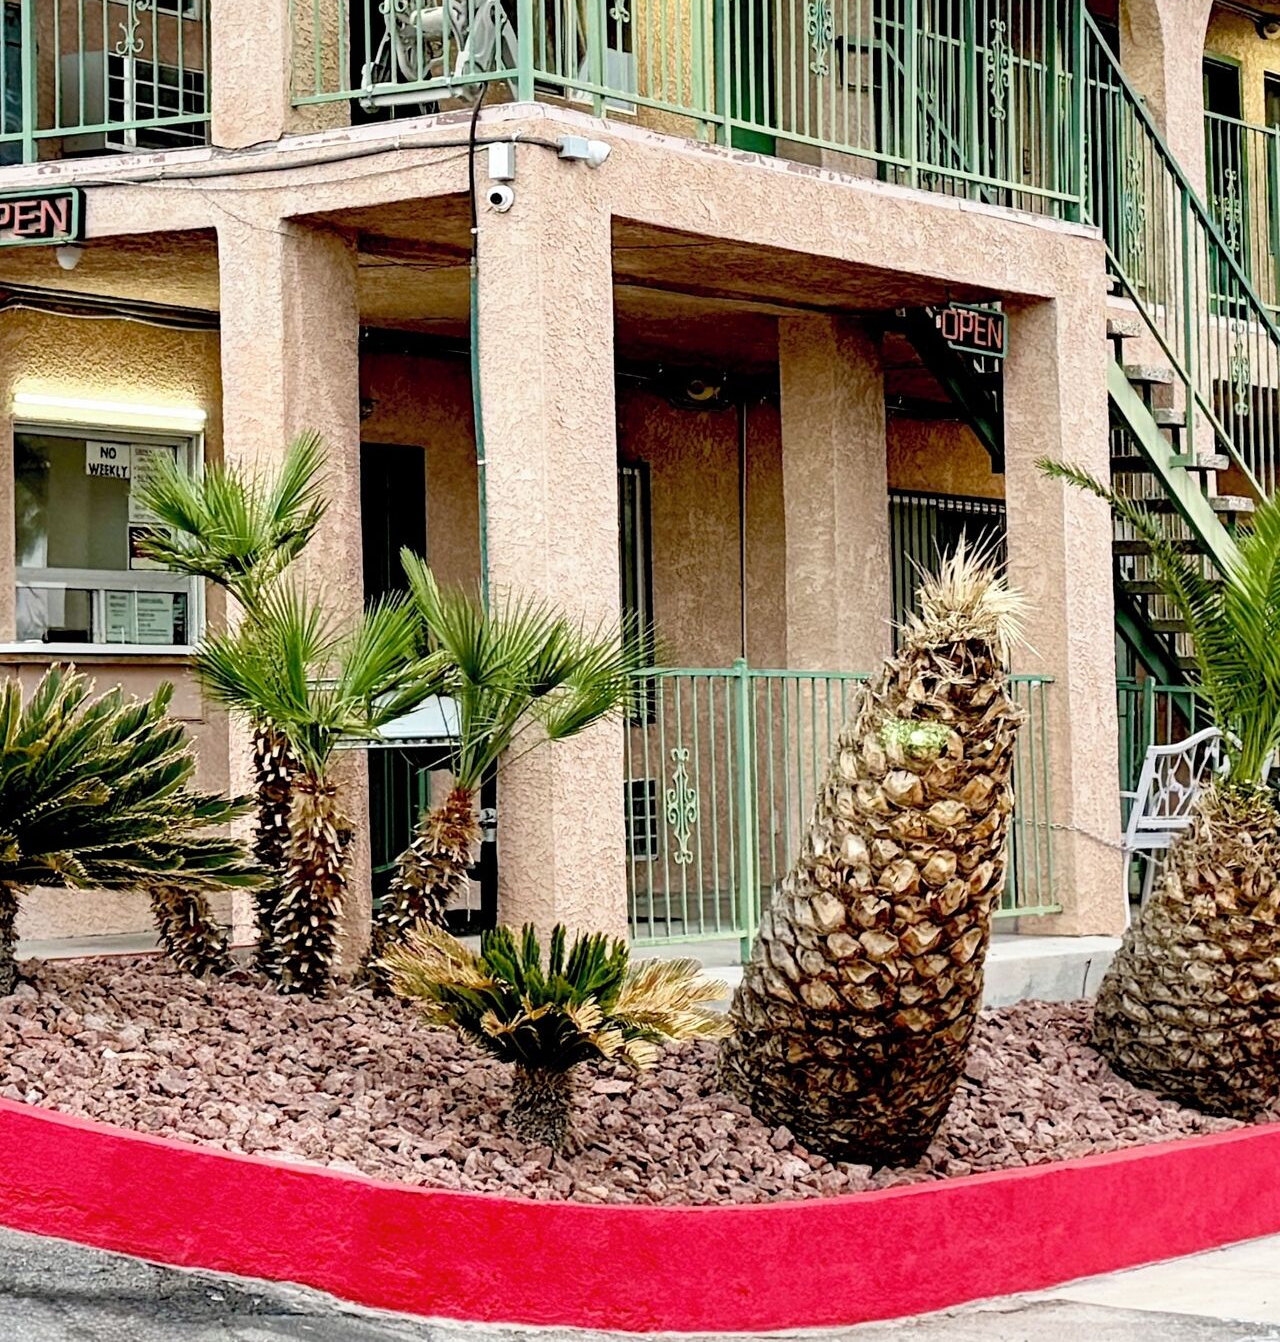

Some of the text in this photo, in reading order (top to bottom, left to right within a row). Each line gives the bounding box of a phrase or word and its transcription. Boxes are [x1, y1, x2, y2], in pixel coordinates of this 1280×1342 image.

[942, 309, 1002, 348] OPEN
[100, 446, 117, 459] NO
[88, 463, 128, 477] WEEKLY
